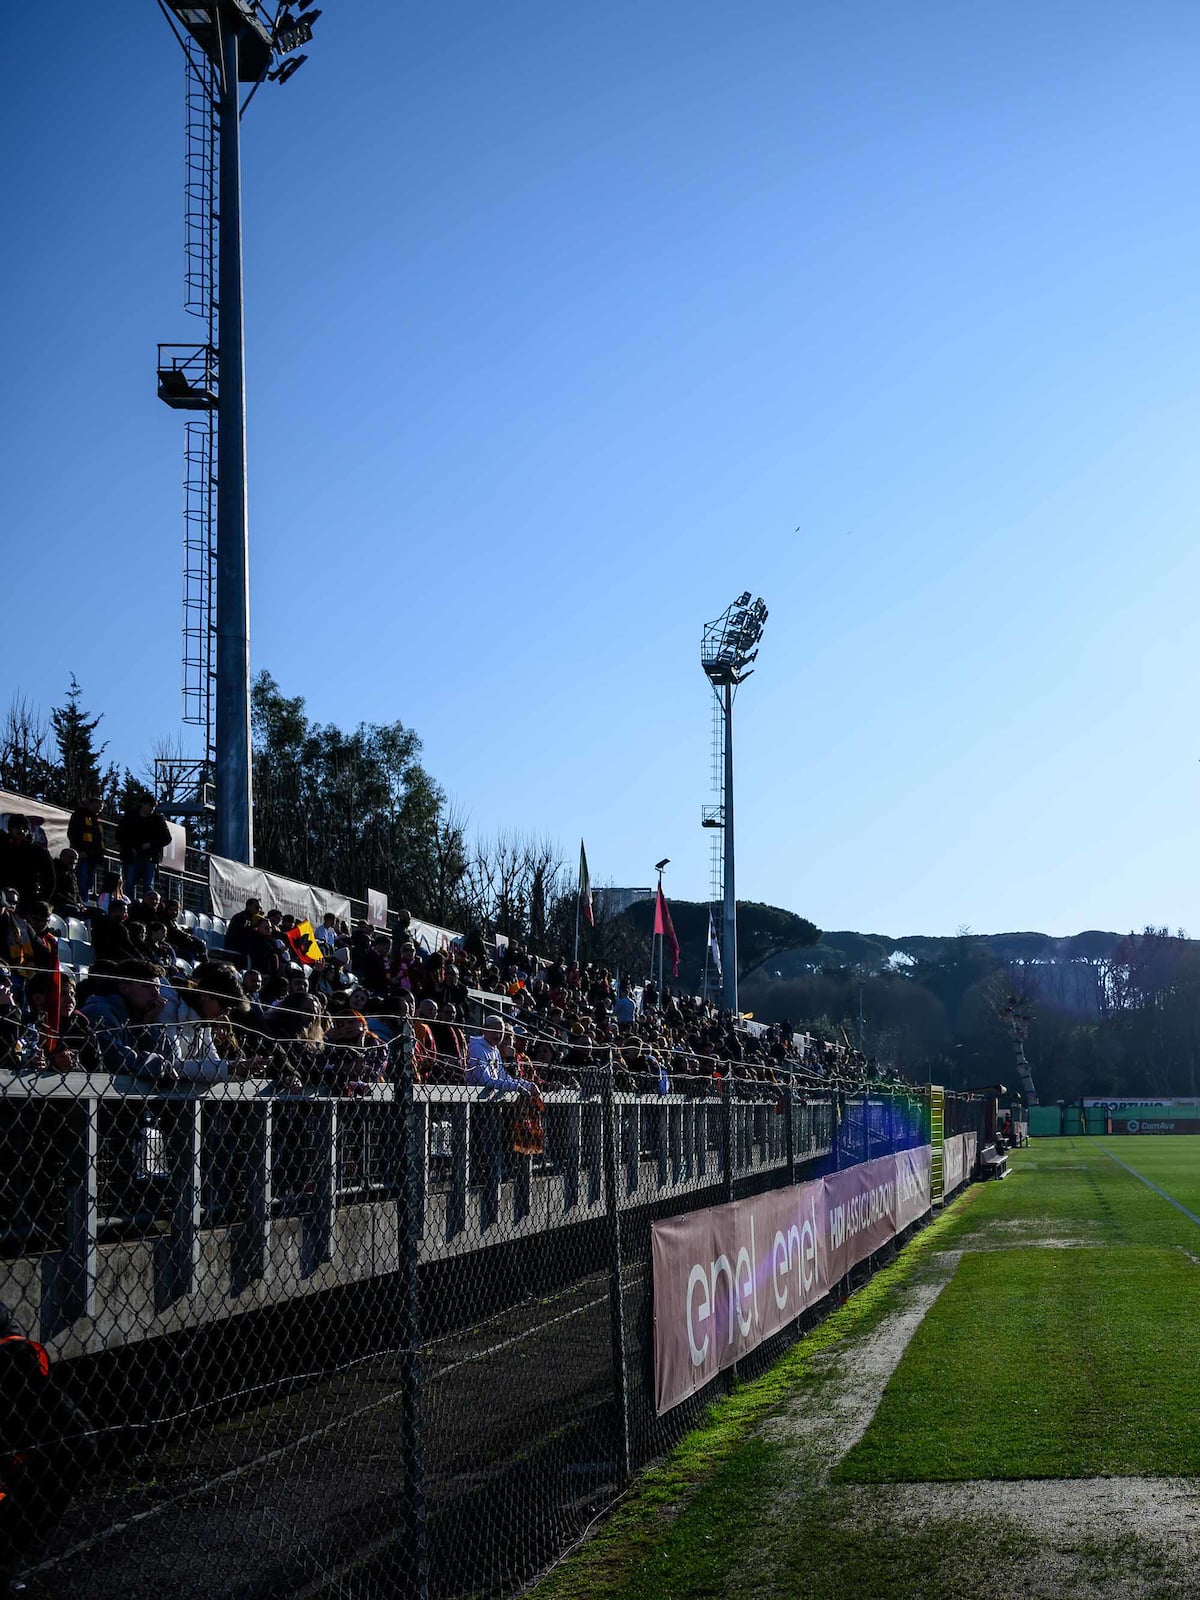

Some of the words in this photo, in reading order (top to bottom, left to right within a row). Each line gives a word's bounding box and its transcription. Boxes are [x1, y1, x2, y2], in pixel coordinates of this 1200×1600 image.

[372, 897, 384, 922] 12
[773, 1195, 819, 1310] enel
[829, 1203, 846, 1252] HDI
[686, 1215, 759, 1367] enel
